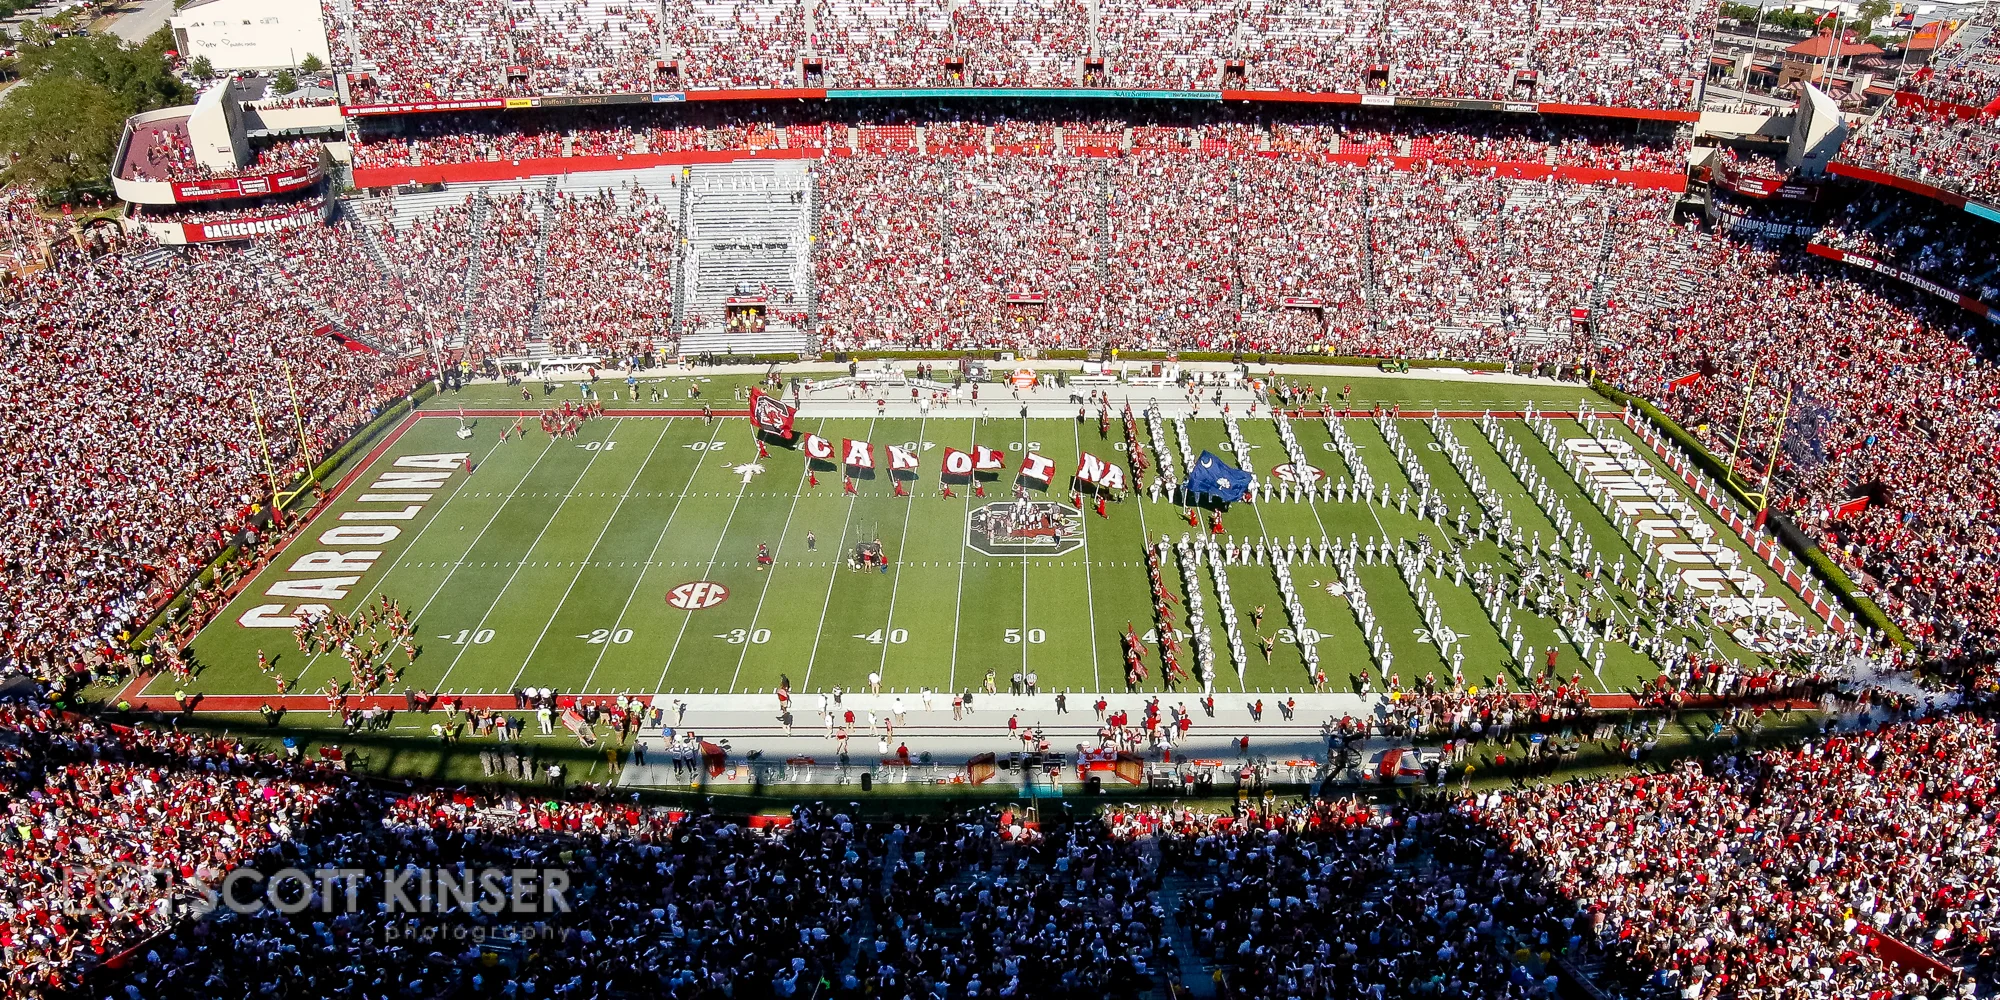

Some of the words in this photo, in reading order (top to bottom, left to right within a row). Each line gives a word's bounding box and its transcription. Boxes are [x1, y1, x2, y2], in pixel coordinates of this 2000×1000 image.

[1506, 103, 1532, 112] verizon
[1875, 262, 1898, 277] ACC
[1899, 271, 1961, 304] CHAMPIONS
[237, 452, 470, 629] CAROLINA
[669, 582, 727, 609] SEC
[452, 629, 496, 645] 10
[586, 629, 634, 645] 20
[727, 628, 771, 644] 30
[865, 628, 909, 644] 40
[1003, 628, 1046, 644] 50
